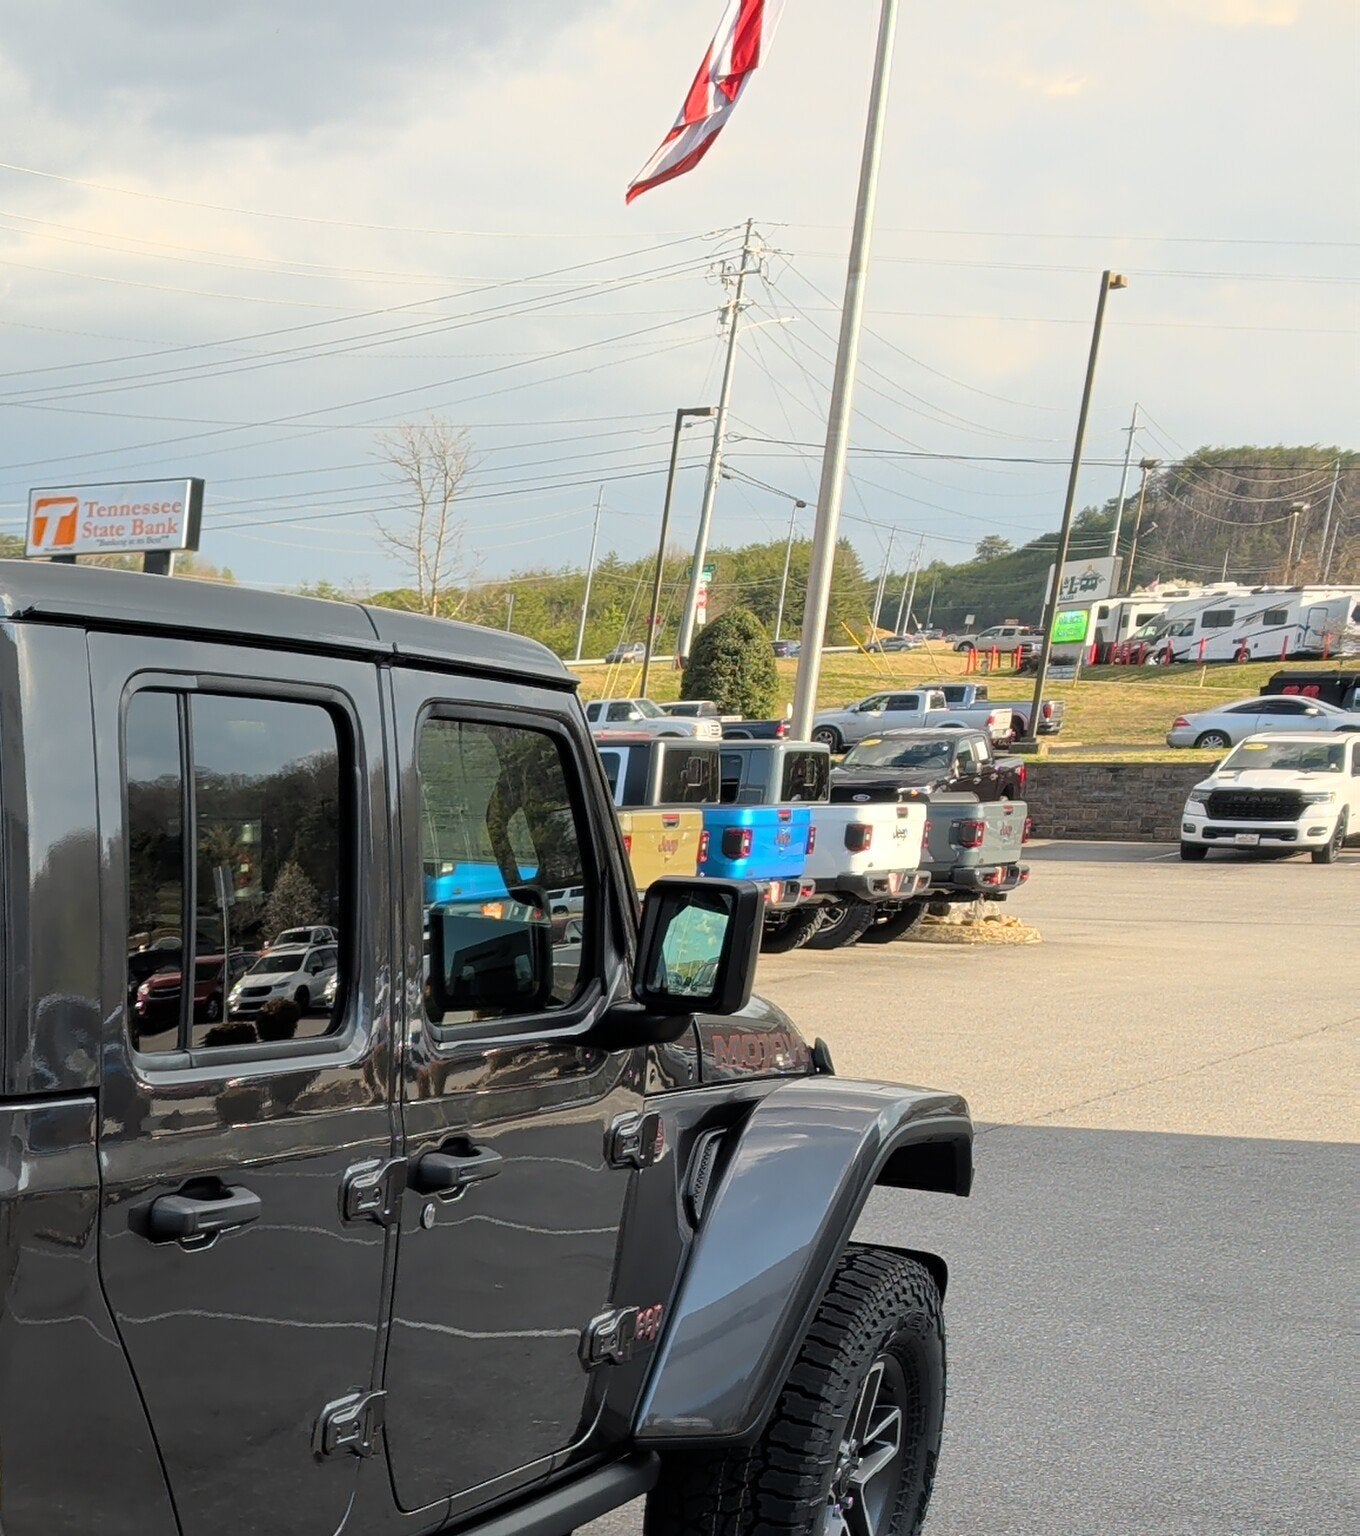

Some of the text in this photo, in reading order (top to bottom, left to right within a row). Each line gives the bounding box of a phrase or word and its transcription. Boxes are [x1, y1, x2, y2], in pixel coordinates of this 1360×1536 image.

[83, 500, 182, 519] Tennessee
[81, 517, 178, 539] State Bank
[635, 1303, 663, 1341] eep
